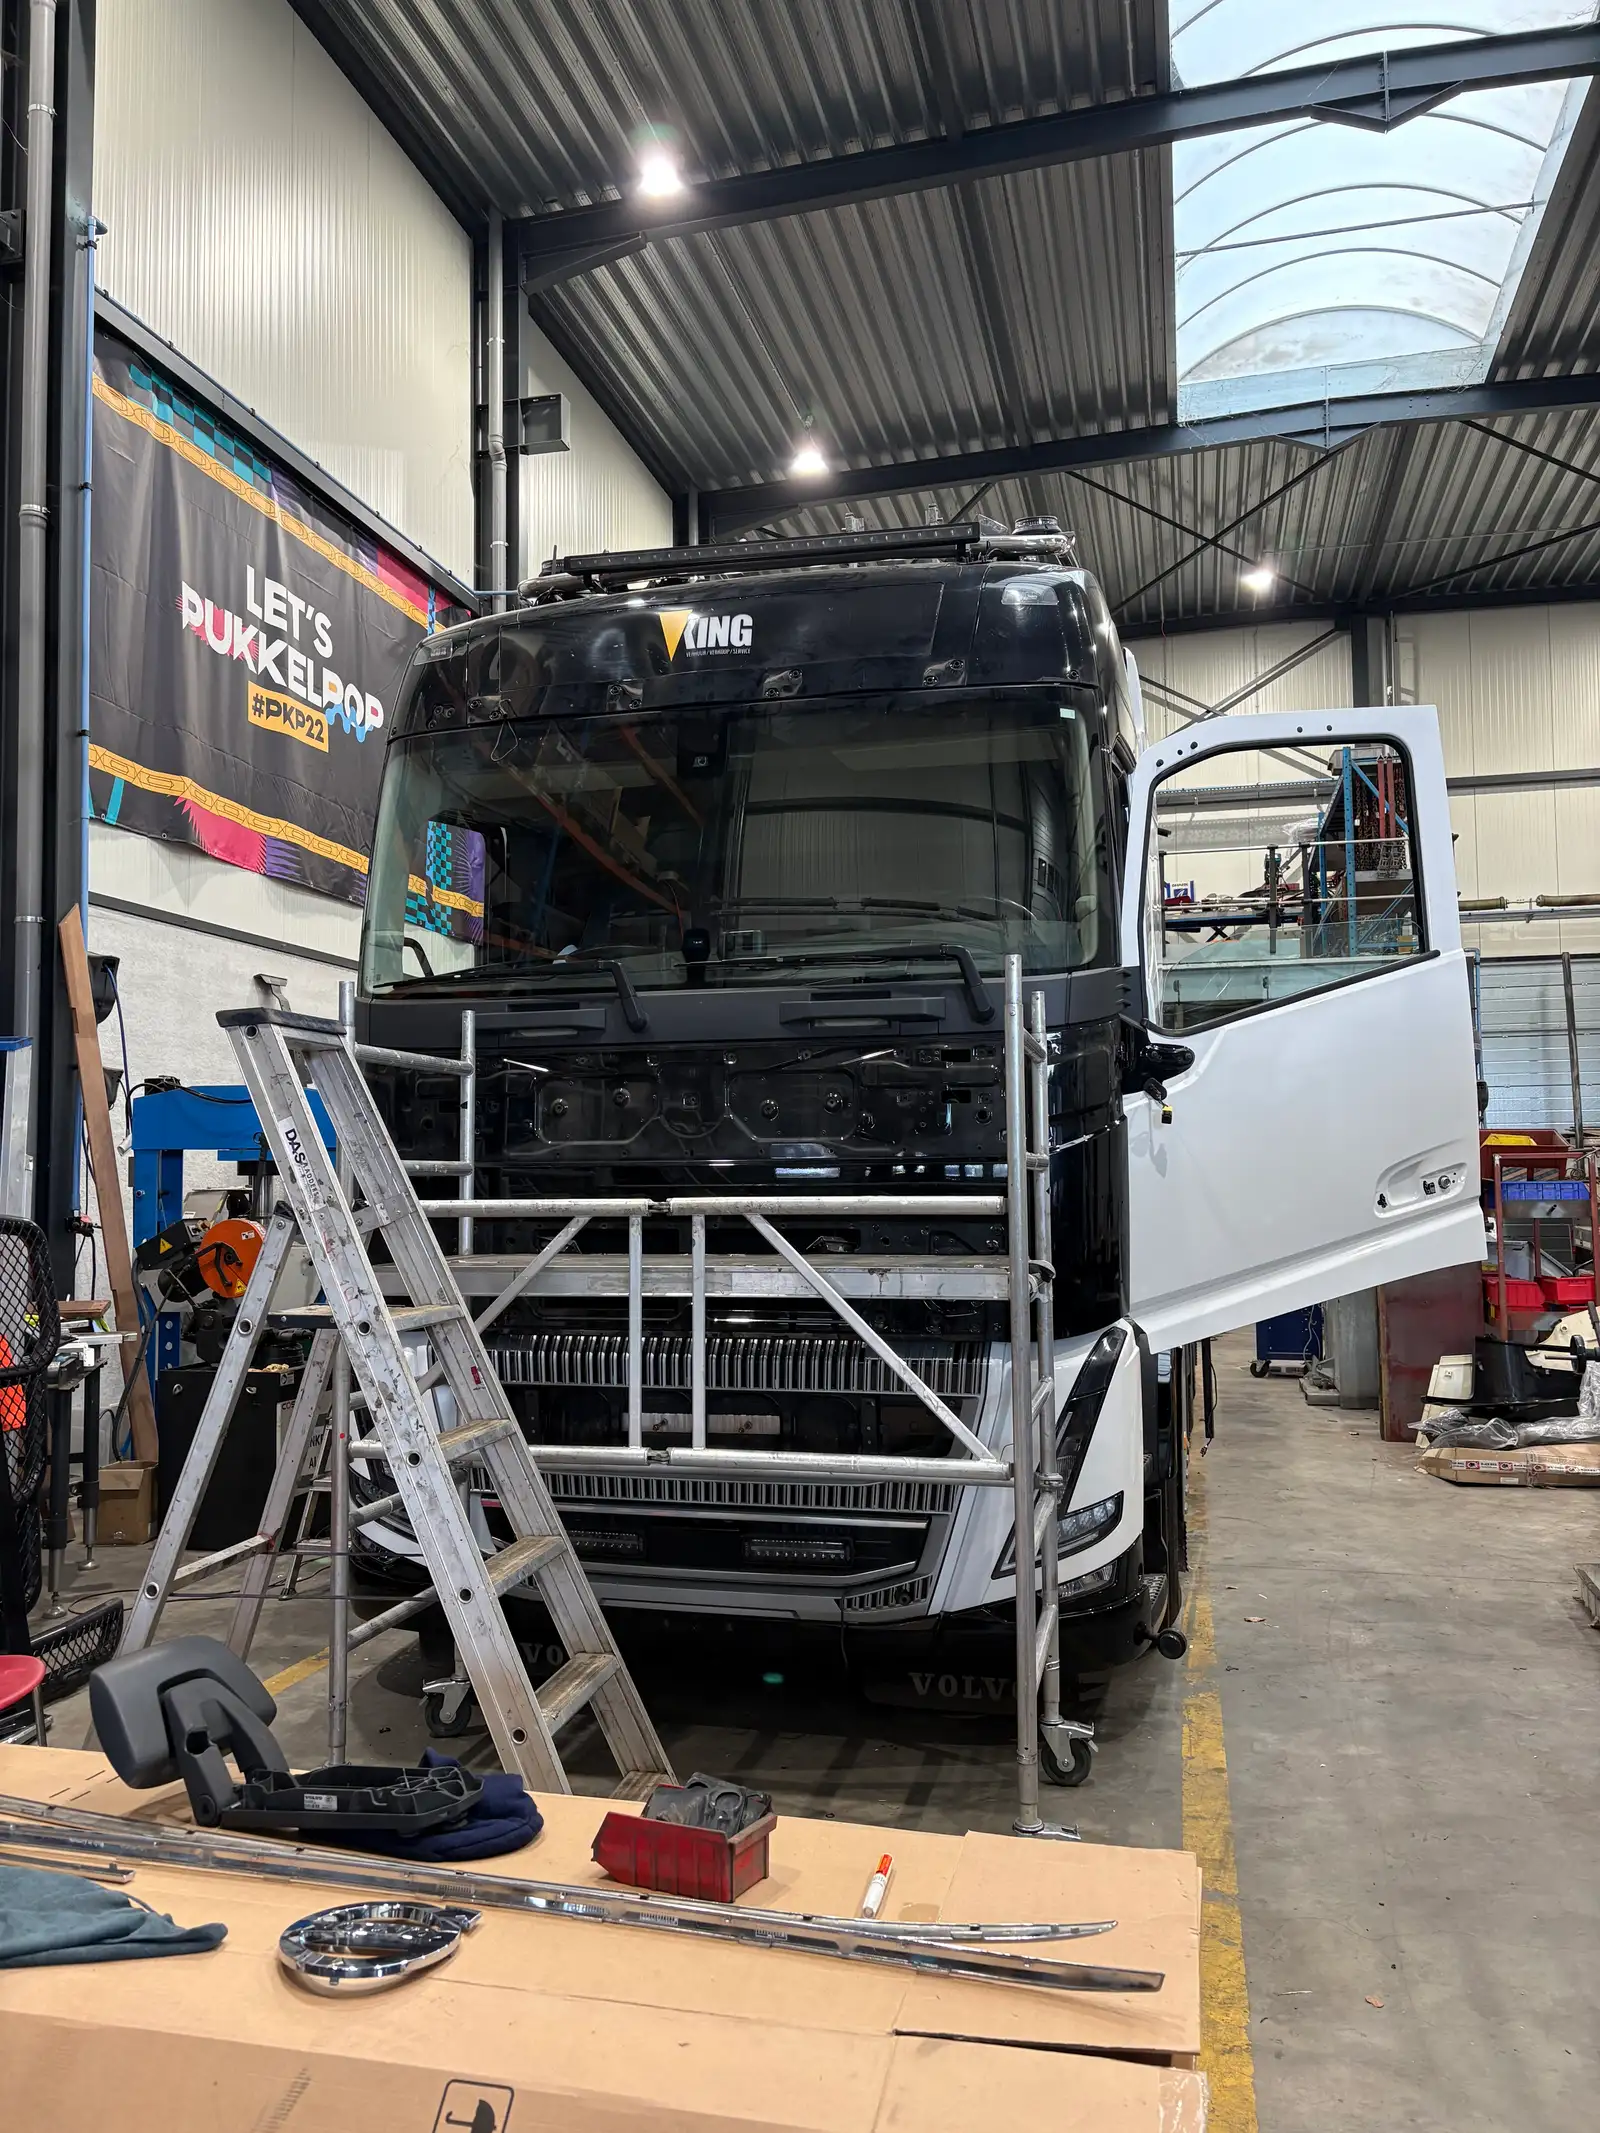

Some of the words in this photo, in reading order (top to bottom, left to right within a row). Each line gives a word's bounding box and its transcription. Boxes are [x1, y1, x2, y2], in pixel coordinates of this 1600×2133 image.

[246, 565, 333, 658] LET'S
[181, 580, 385, 732] PUKKELPOP
[252, 692, 325, 743] #PKP22
[285, 1128, 306, 1165] DAS
[908, 1672, 1018, 1701] VOLV
